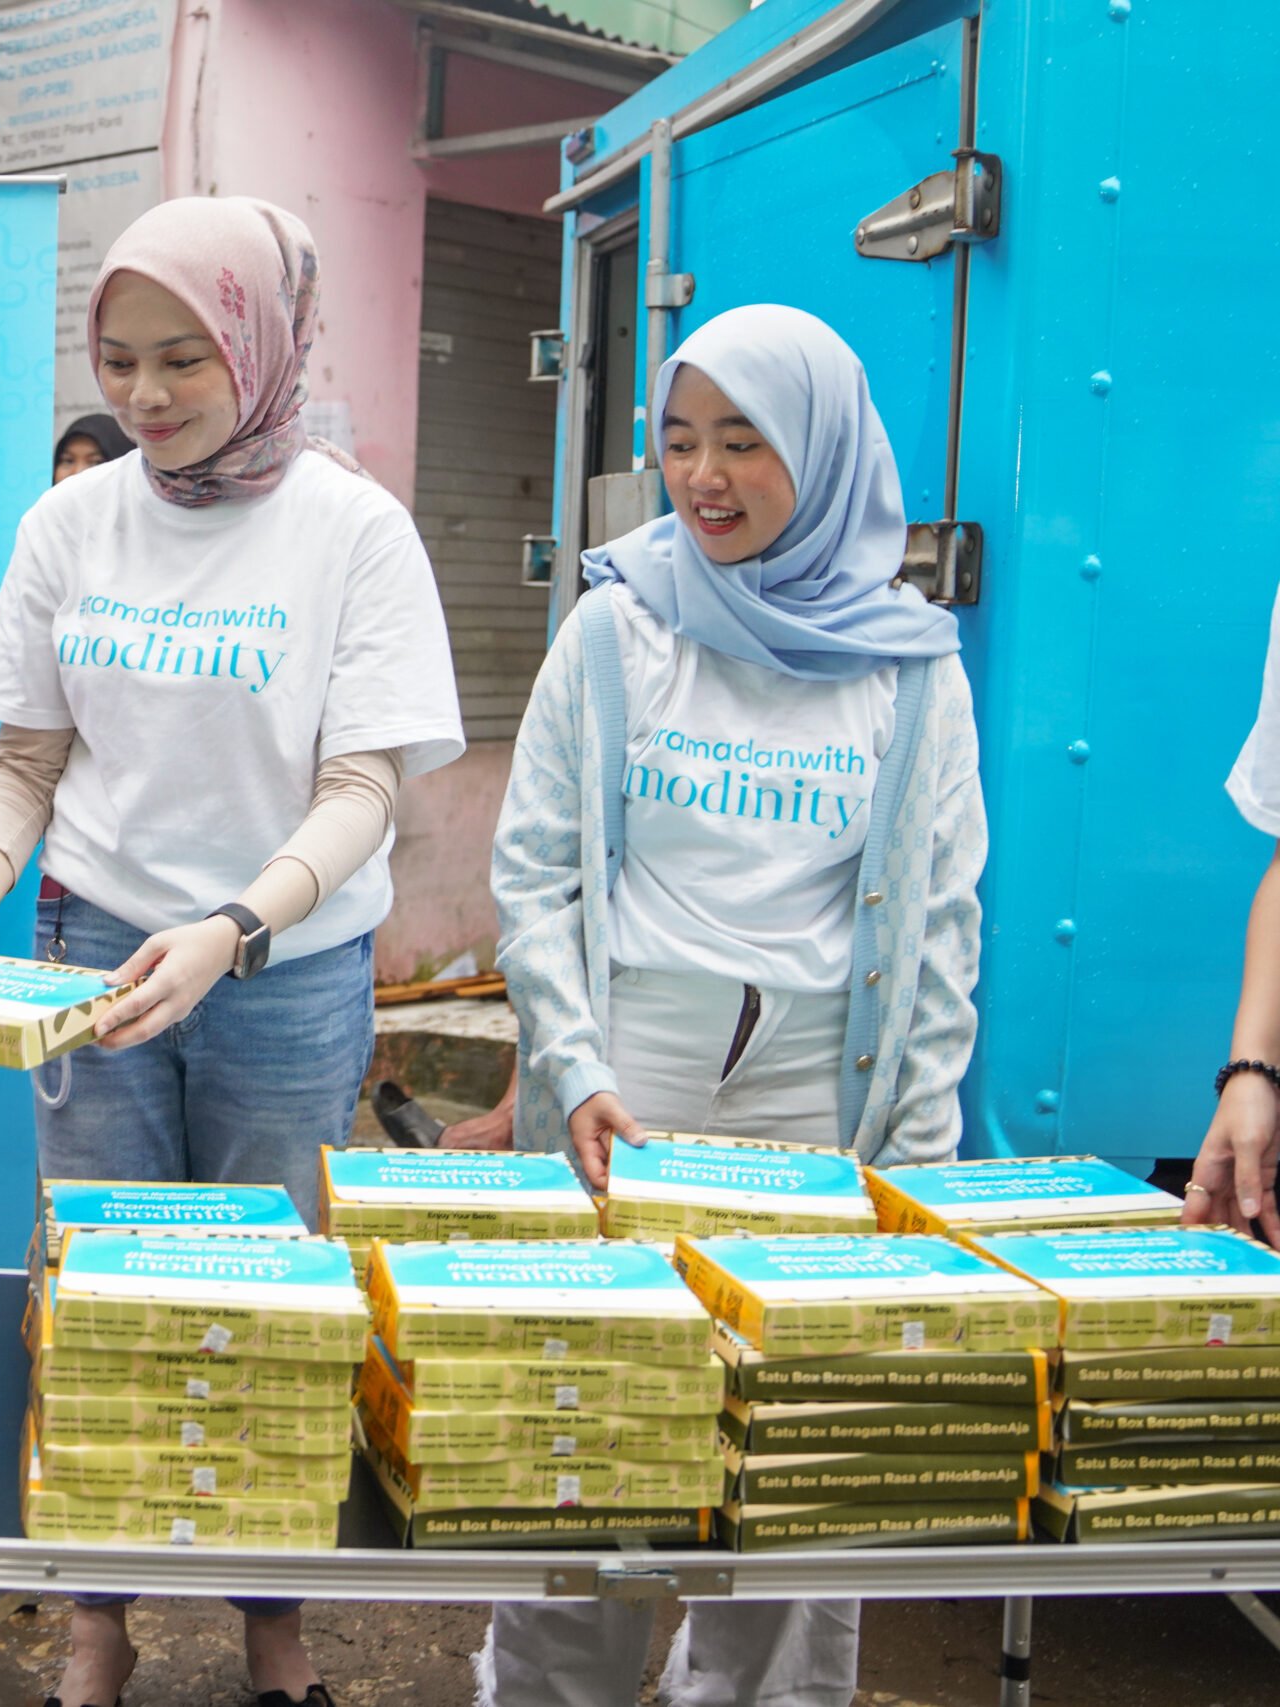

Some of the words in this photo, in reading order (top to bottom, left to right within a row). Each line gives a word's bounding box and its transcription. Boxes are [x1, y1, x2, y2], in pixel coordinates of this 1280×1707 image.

[59, 632, 289, 694] modinity
[625, 762, 866, 840] modinity
[171, 1306, 198, 1318] Enjoy
[199, 1307, 221, 1318] Your
[222, 1308, 252, 1319] Bento
[757, 1370, 790, 1384] Satu
[792, 1371, 820, 1384] Box
[822, 1371, 885, 1386] Beragam
[888, 1372, 921, 1385] Rasa
[924, 1371, 939, 1385] di
[1078, 1368, 1110, 1381] Satu
[1113, 1368, 1140, 1381] Box
[1142, 1368, 1204, 1382] Beragam
[1206, 1367, 1239, 1380] Rasa
[1242, 1366, 1257, 1380] di
[1082, 1416, 1115, 1429] Satu
[1117, 1416, 1144, 1429] Box
[1146, 1416, 1207, 1430] Beragam
[1209, 1414, 1242, 1427] Rasa
[1245, 1413, 1259, 1426] di
[766, 1426, 798, 1439] Satu
[801, 1426, 827, 1438] Box
[830, 1425, 891, 1439] Beragam
[894, 1424, 927, 1436] Rasa
[929, 1423, 944, 1435] di
[1075, 1457, 1107, 1470] Satu
[1109, 1457, 1136, 1469] Box
[1138, 1456, 1200, 1470] Beragam
[1203, 1455, 1236, 1468] Rasa
[1238, 1454, 1253, 1467] di
[757, 1476, 789, 1489] Satu
[792, 1475, 818, 1488] Box
[821, 1474, 882, 1489] Beragam
[884, 1473, 916, 1485] Rasa
[919, 1471, 933, 1484] di
[426, 1518, 459, 1533] Satu
[461, 1518, 488, 1532] Box
[490, 1517, 552, 1533] Beragam
[554, 1517, 588, 1530] Rasa
[590, 1515, 605, 1529] di
[755, 1524, 786, 1537] Satu
[789, 1523, 815, 1536] Box
[818, 1521, 878, 1537] Beragam
[880, 1519, 912, 1532] Rasa
[914, 1517, 928, 1530] di
[1091, 1516, 1122, 1529] Satu
[1125, 1515, 1152, 1527] Box
[1154, 1513, 1215, 1528] Beragam
[1217, 1511, 1250, 1524] Rasa
[1252, 1510, 1266, 1522] di
